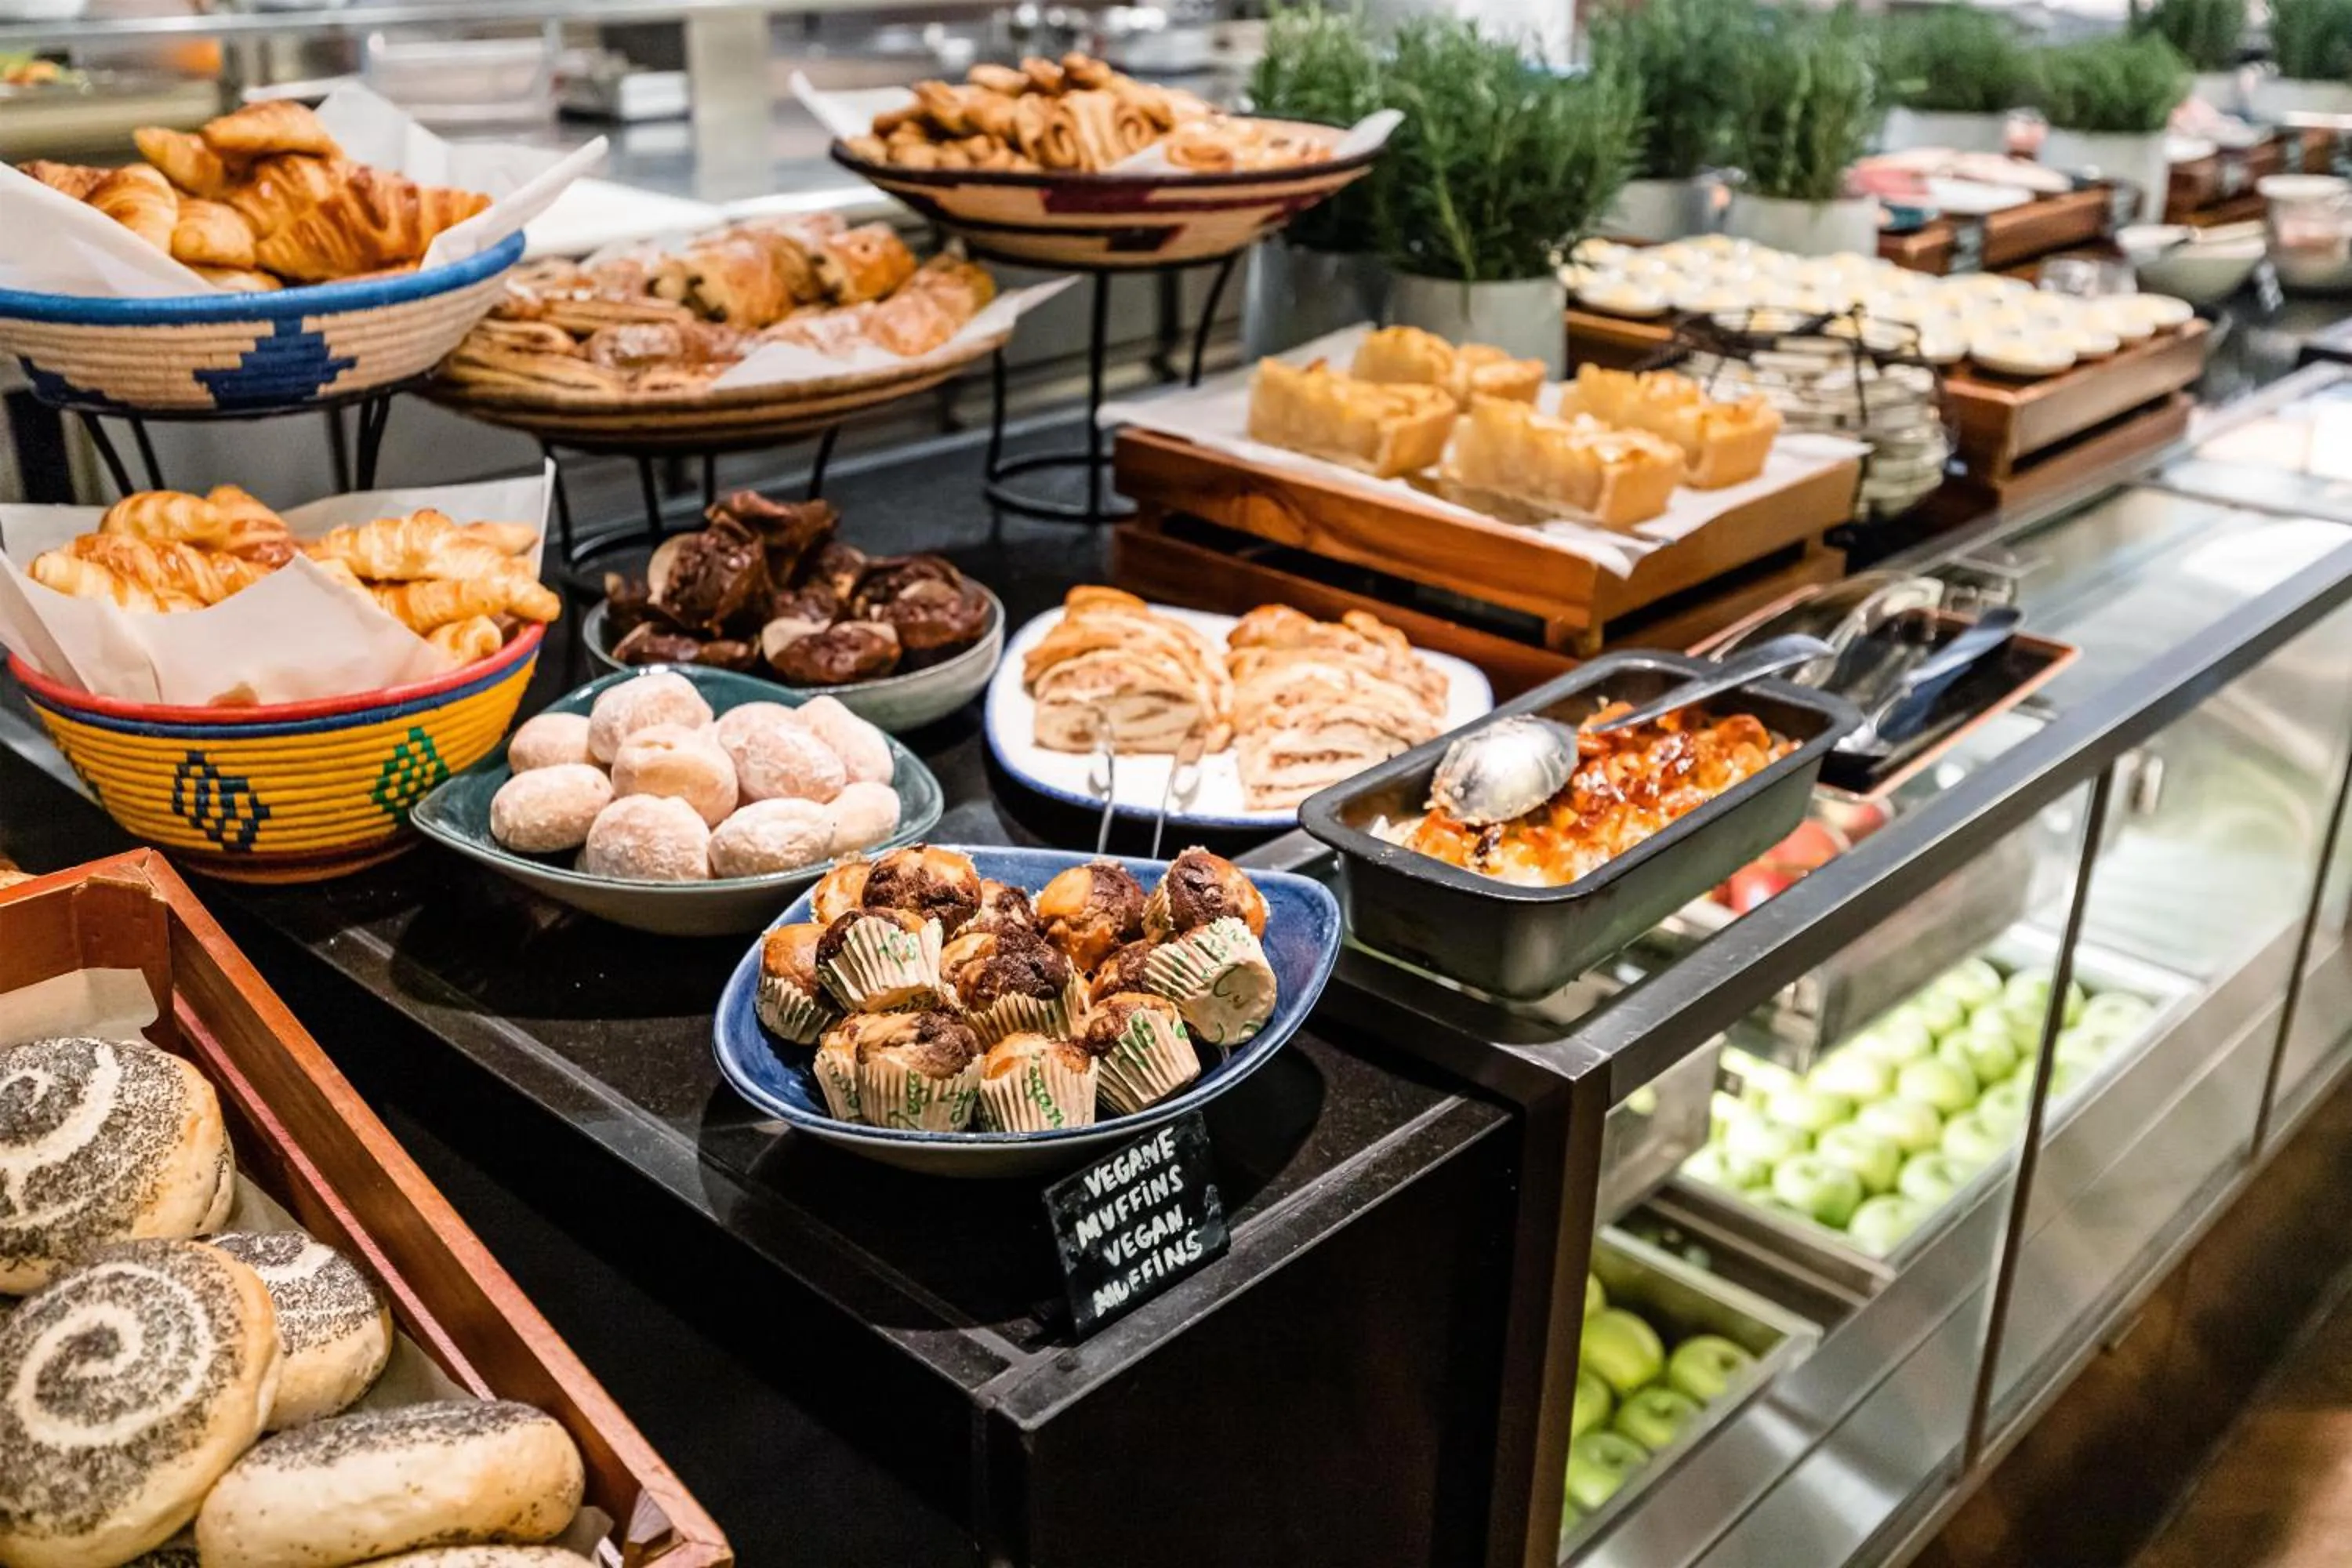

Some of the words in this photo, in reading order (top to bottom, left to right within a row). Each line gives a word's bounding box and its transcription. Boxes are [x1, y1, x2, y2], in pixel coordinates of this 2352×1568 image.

[1083, 1127, 1176, 1198] VEGANE
[1076, 1164, 1184, 1249] MUFFINS
[1093, 1229, 1203, 1317] MUFFINS
